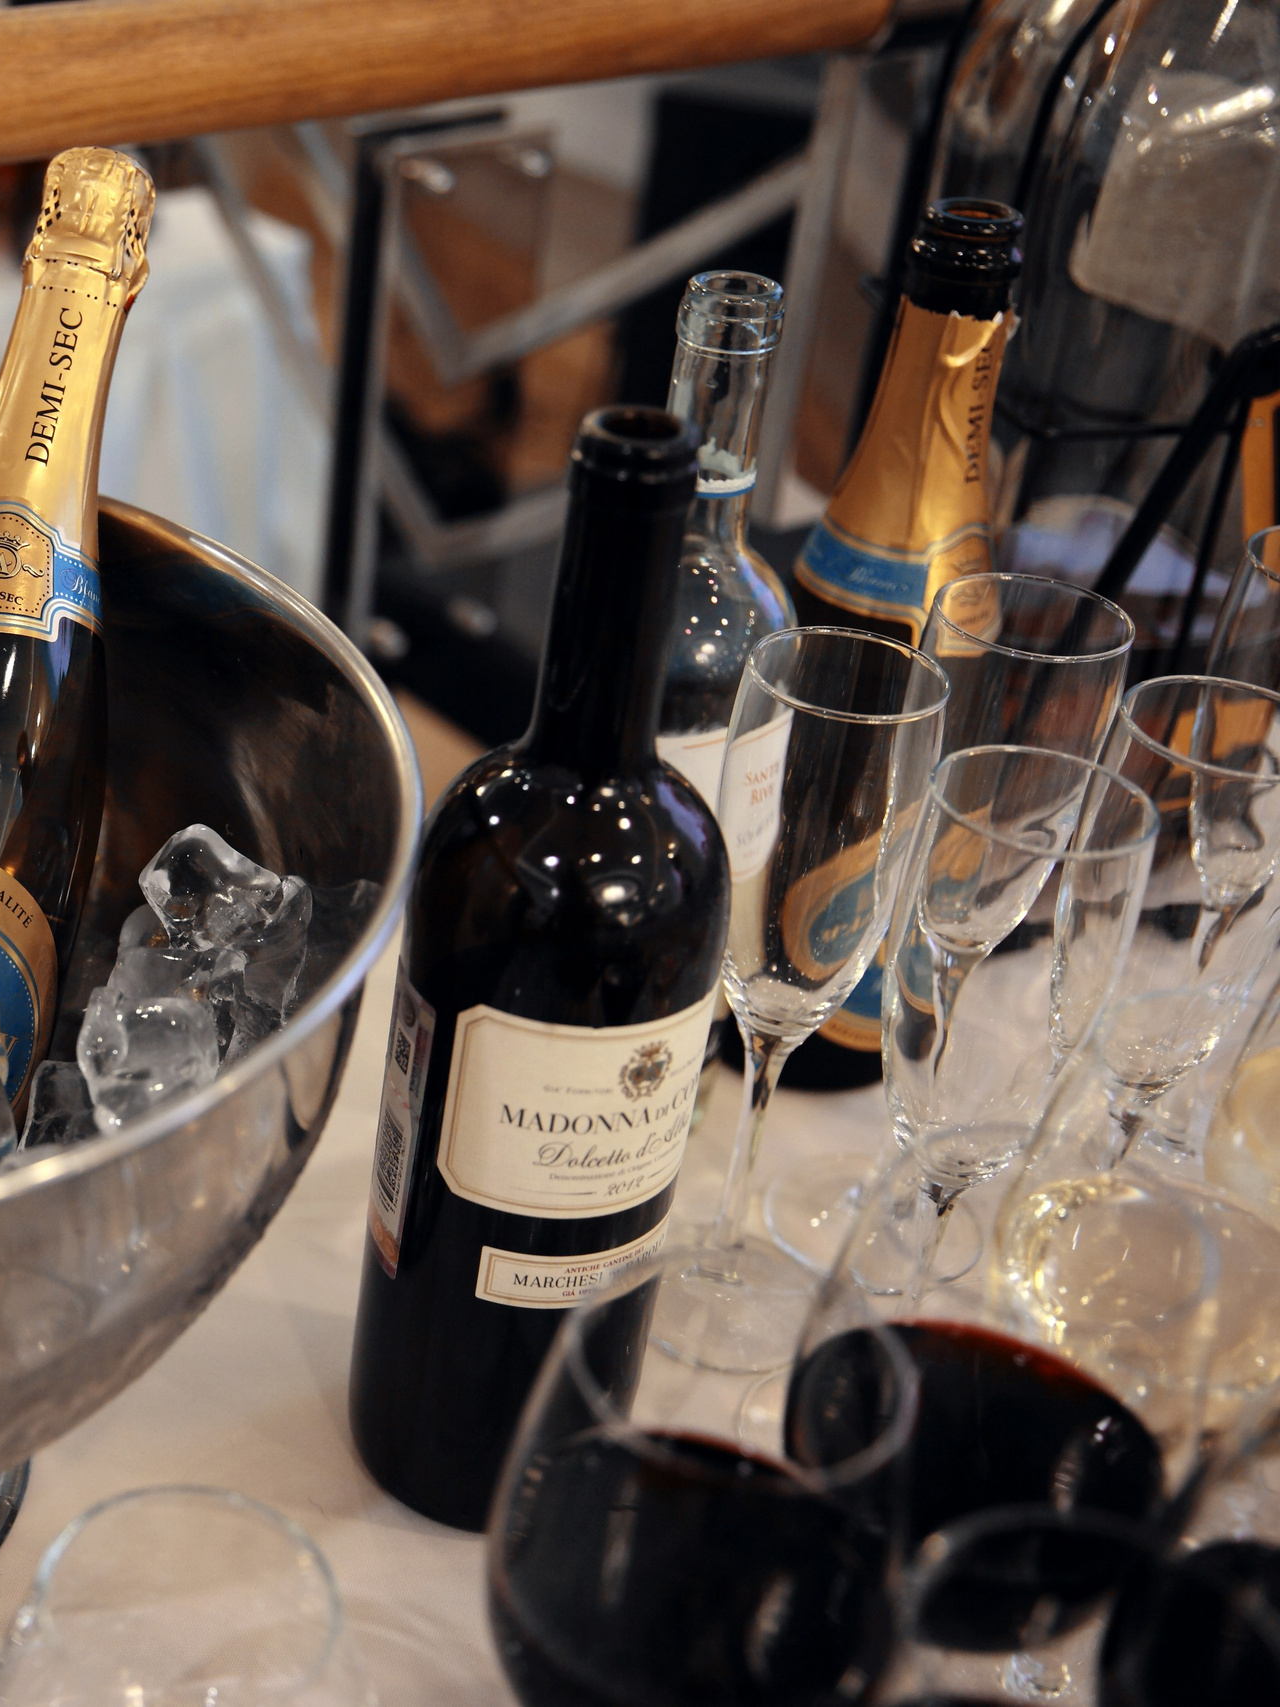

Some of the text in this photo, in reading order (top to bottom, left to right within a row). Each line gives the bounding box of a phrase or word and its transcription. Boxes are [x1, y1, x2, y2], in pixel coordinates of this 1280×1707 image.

[24, 307, 83, 467] DEMI-SEC
[499, 1103, 651, 1135] MADONNA
[655, 1104, 669, 1121] DI
[533, 1141, 631, 1168] Dolcetto
[564, 1263, 601, 1274] ANTICHE
[603, 1252, 634, 1268] CANTINE
[513, 1271, 603, 1289] MARCHESI
